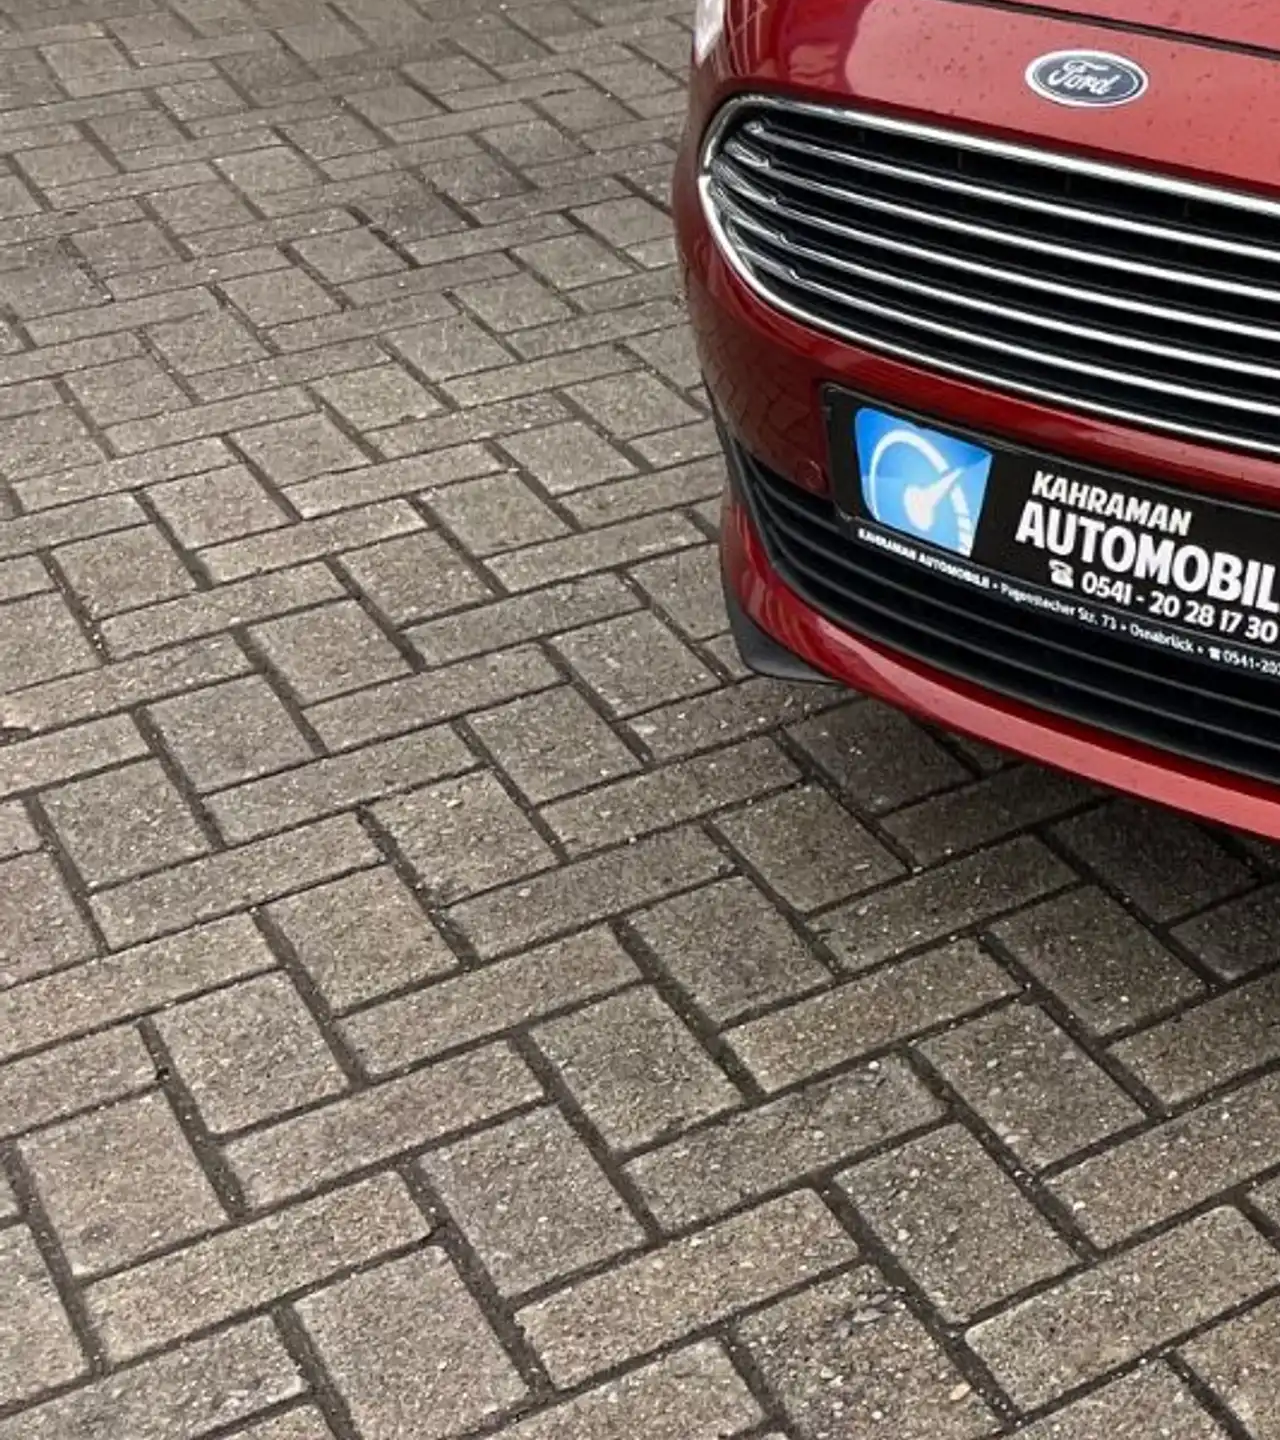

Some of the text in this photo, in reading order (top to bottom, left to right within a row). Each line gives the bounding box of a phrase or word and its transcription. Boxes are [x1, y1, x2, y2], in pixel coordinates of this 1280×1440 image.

[1047, 59, 1121, 96] Ford
[1032, 470, 1192, 536] KAHRAMAN
[857, 528, 917, 562] KAHRAMAN
[919, 551, 991, 589] AUTOMOBILE
[1078, 607, 1099, 626] Str.
[1102, 614, 1117, 631] 73
[1130, 623, 1194, 653] Osnabrück
[1081, 571, 1132, 605] 0541
[1149, 591, 1180, 617] 20
[1184, 601, 1215, 627] 28
[1219, 609, 1243, 633] 17
[1245, 616, 1279, 644] 30
